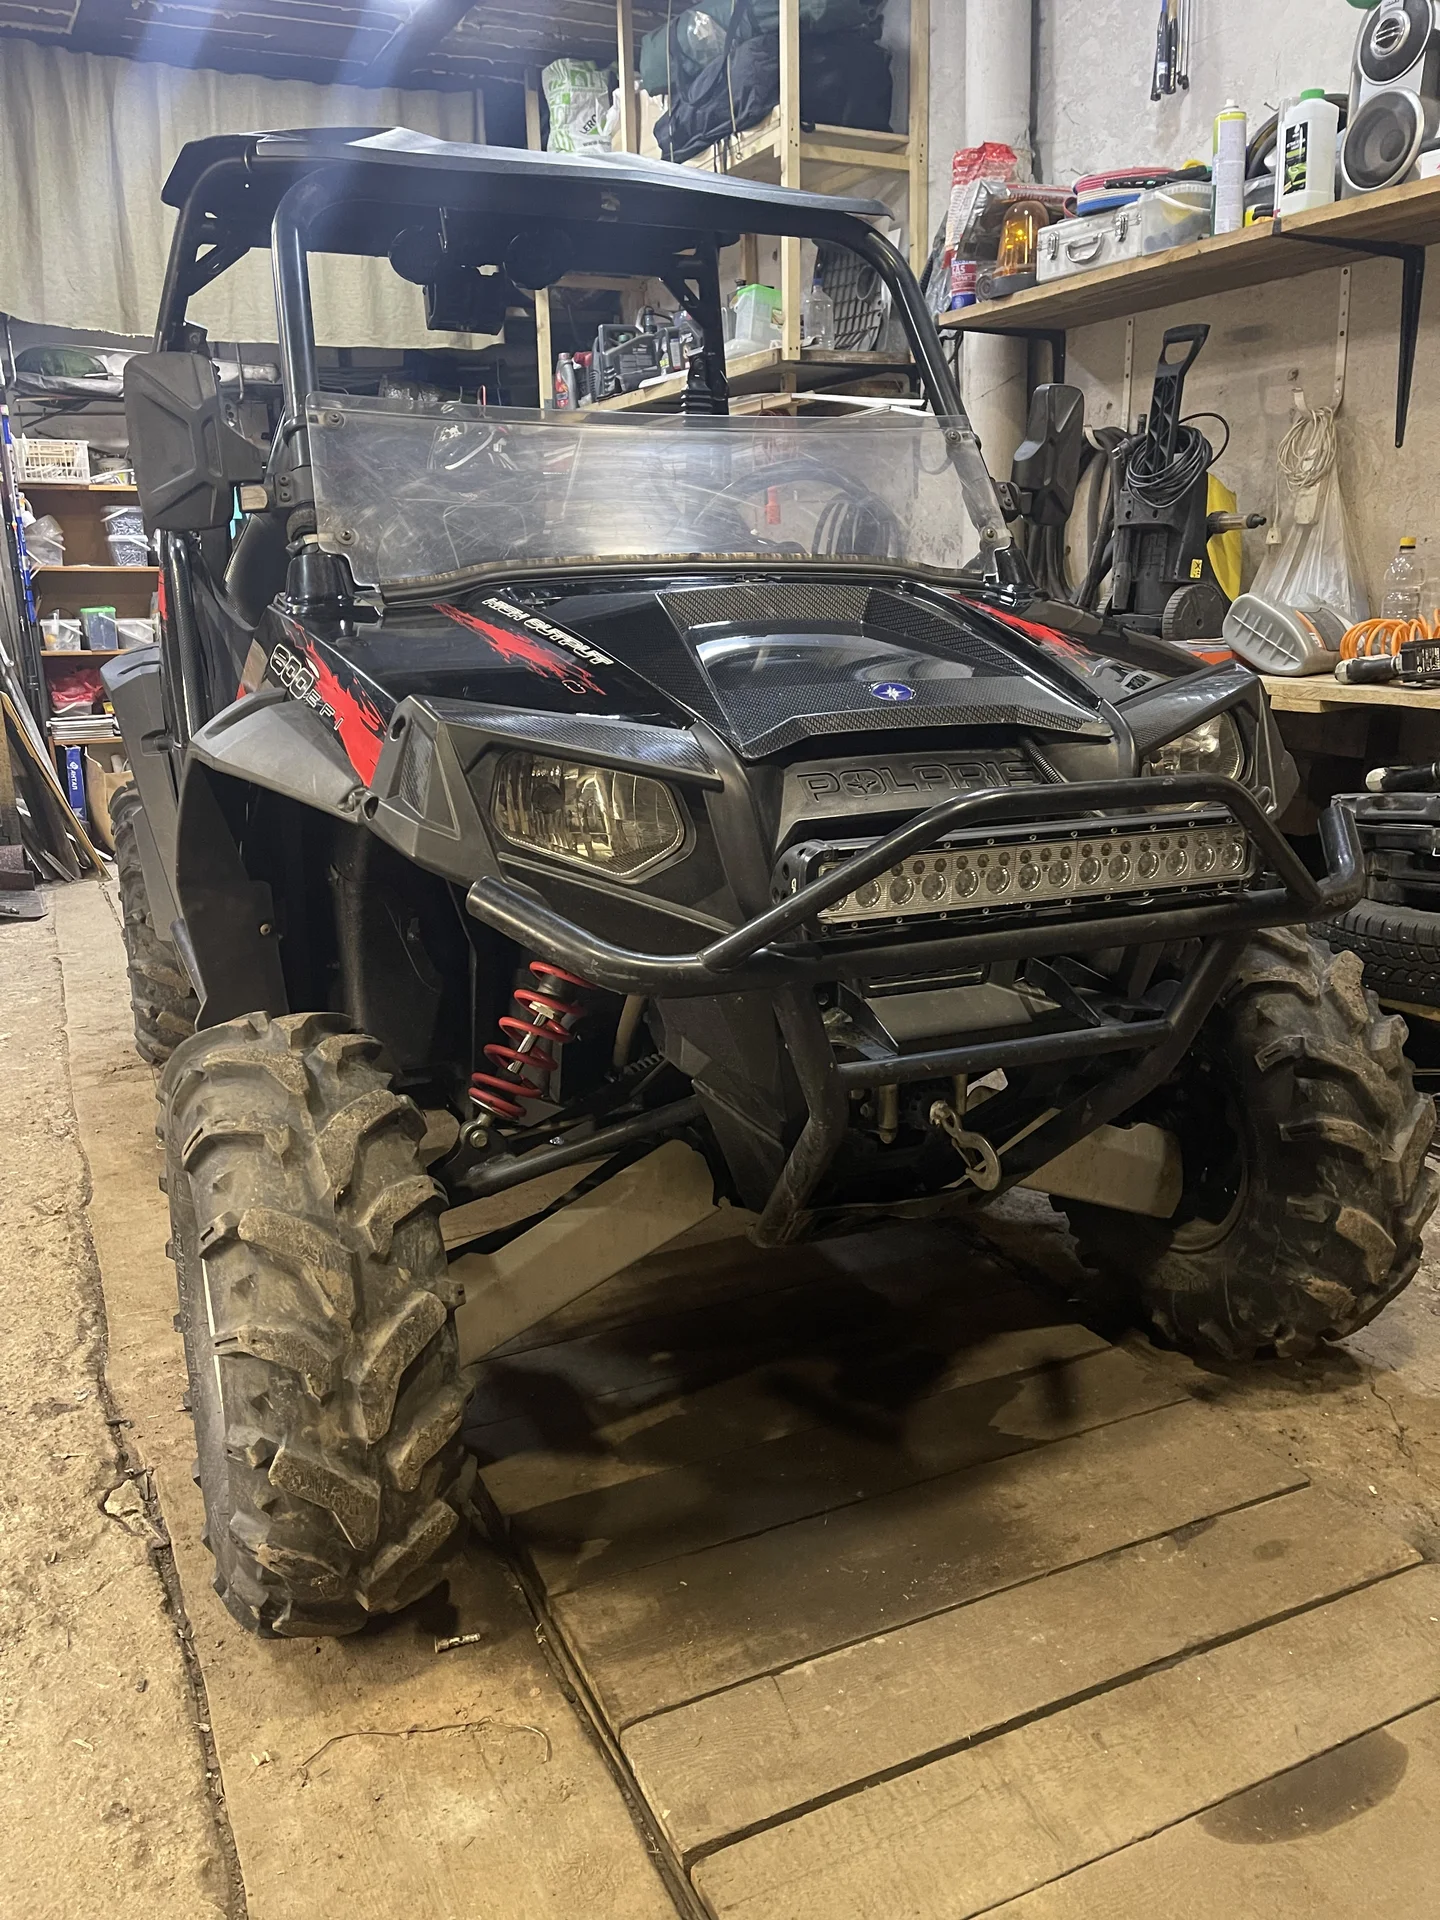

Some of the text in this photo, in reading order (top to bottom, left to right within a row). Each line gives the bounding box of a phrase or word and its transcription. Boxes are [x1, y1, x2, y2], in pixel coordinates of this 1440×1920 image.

[481, 597, 614, 665] HIGH OUTPUT
[269, 643, 344, 731] 800 EFI
[796, 759, 1040, 803] POLARIS
